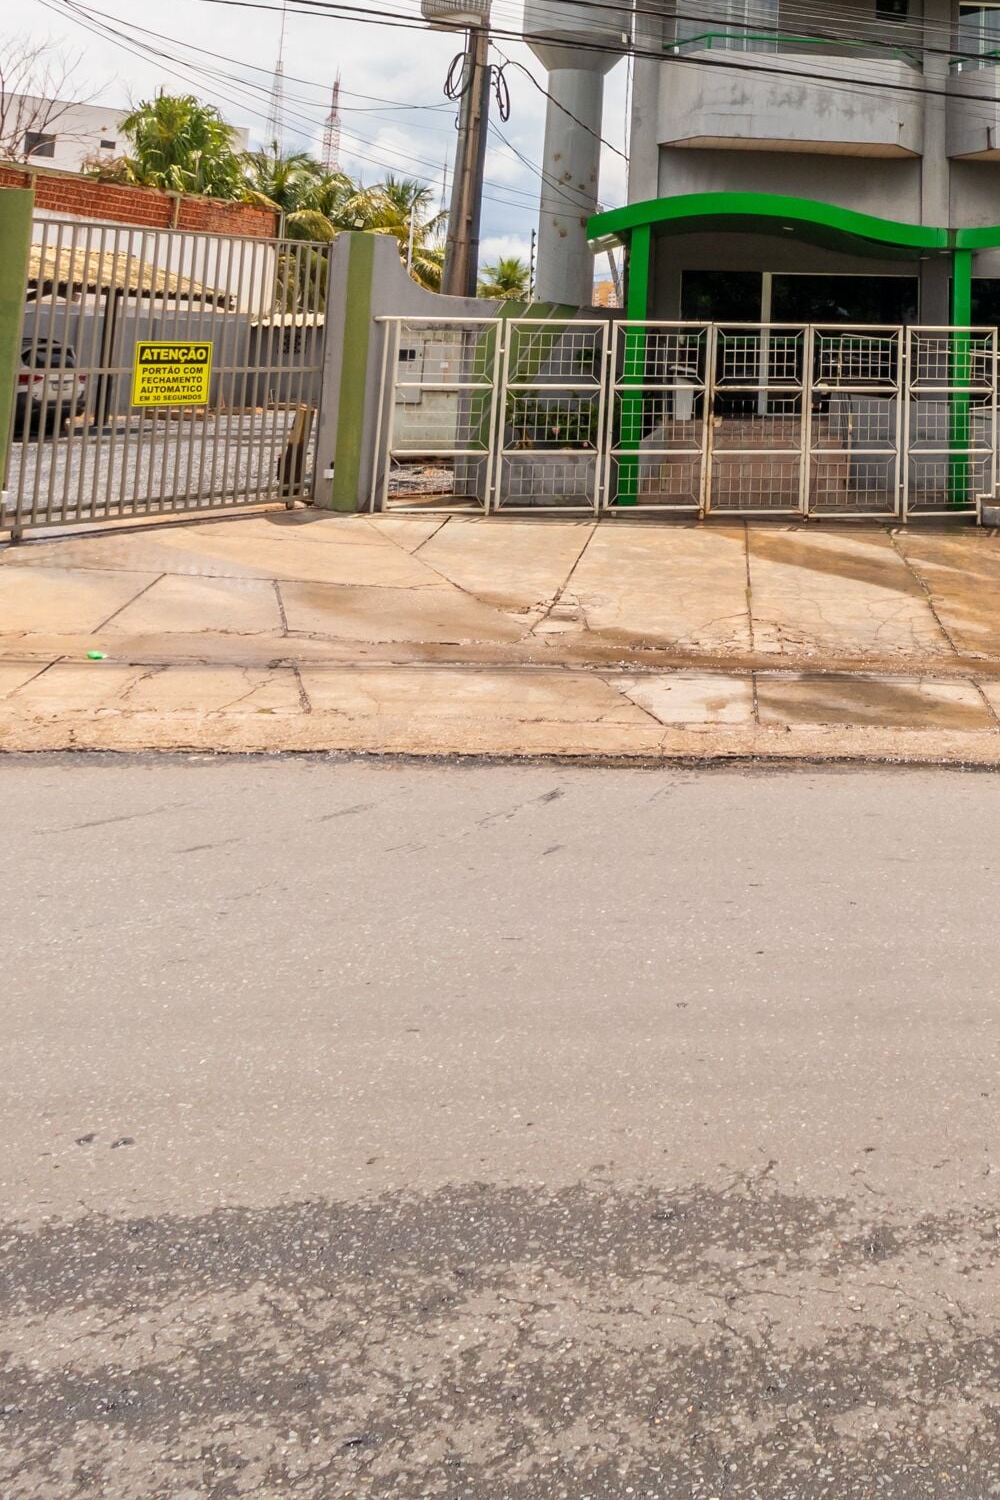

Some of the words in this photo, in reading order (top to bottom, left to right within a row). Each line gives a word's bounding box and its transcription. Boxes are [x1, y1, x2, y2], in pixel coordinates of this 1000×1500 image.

[141, 347, 207, 363] ATENÇÃO
[142, 366, 180, 375] PORTÃO
[141, 376, 202, 384] FECHAMENTO
